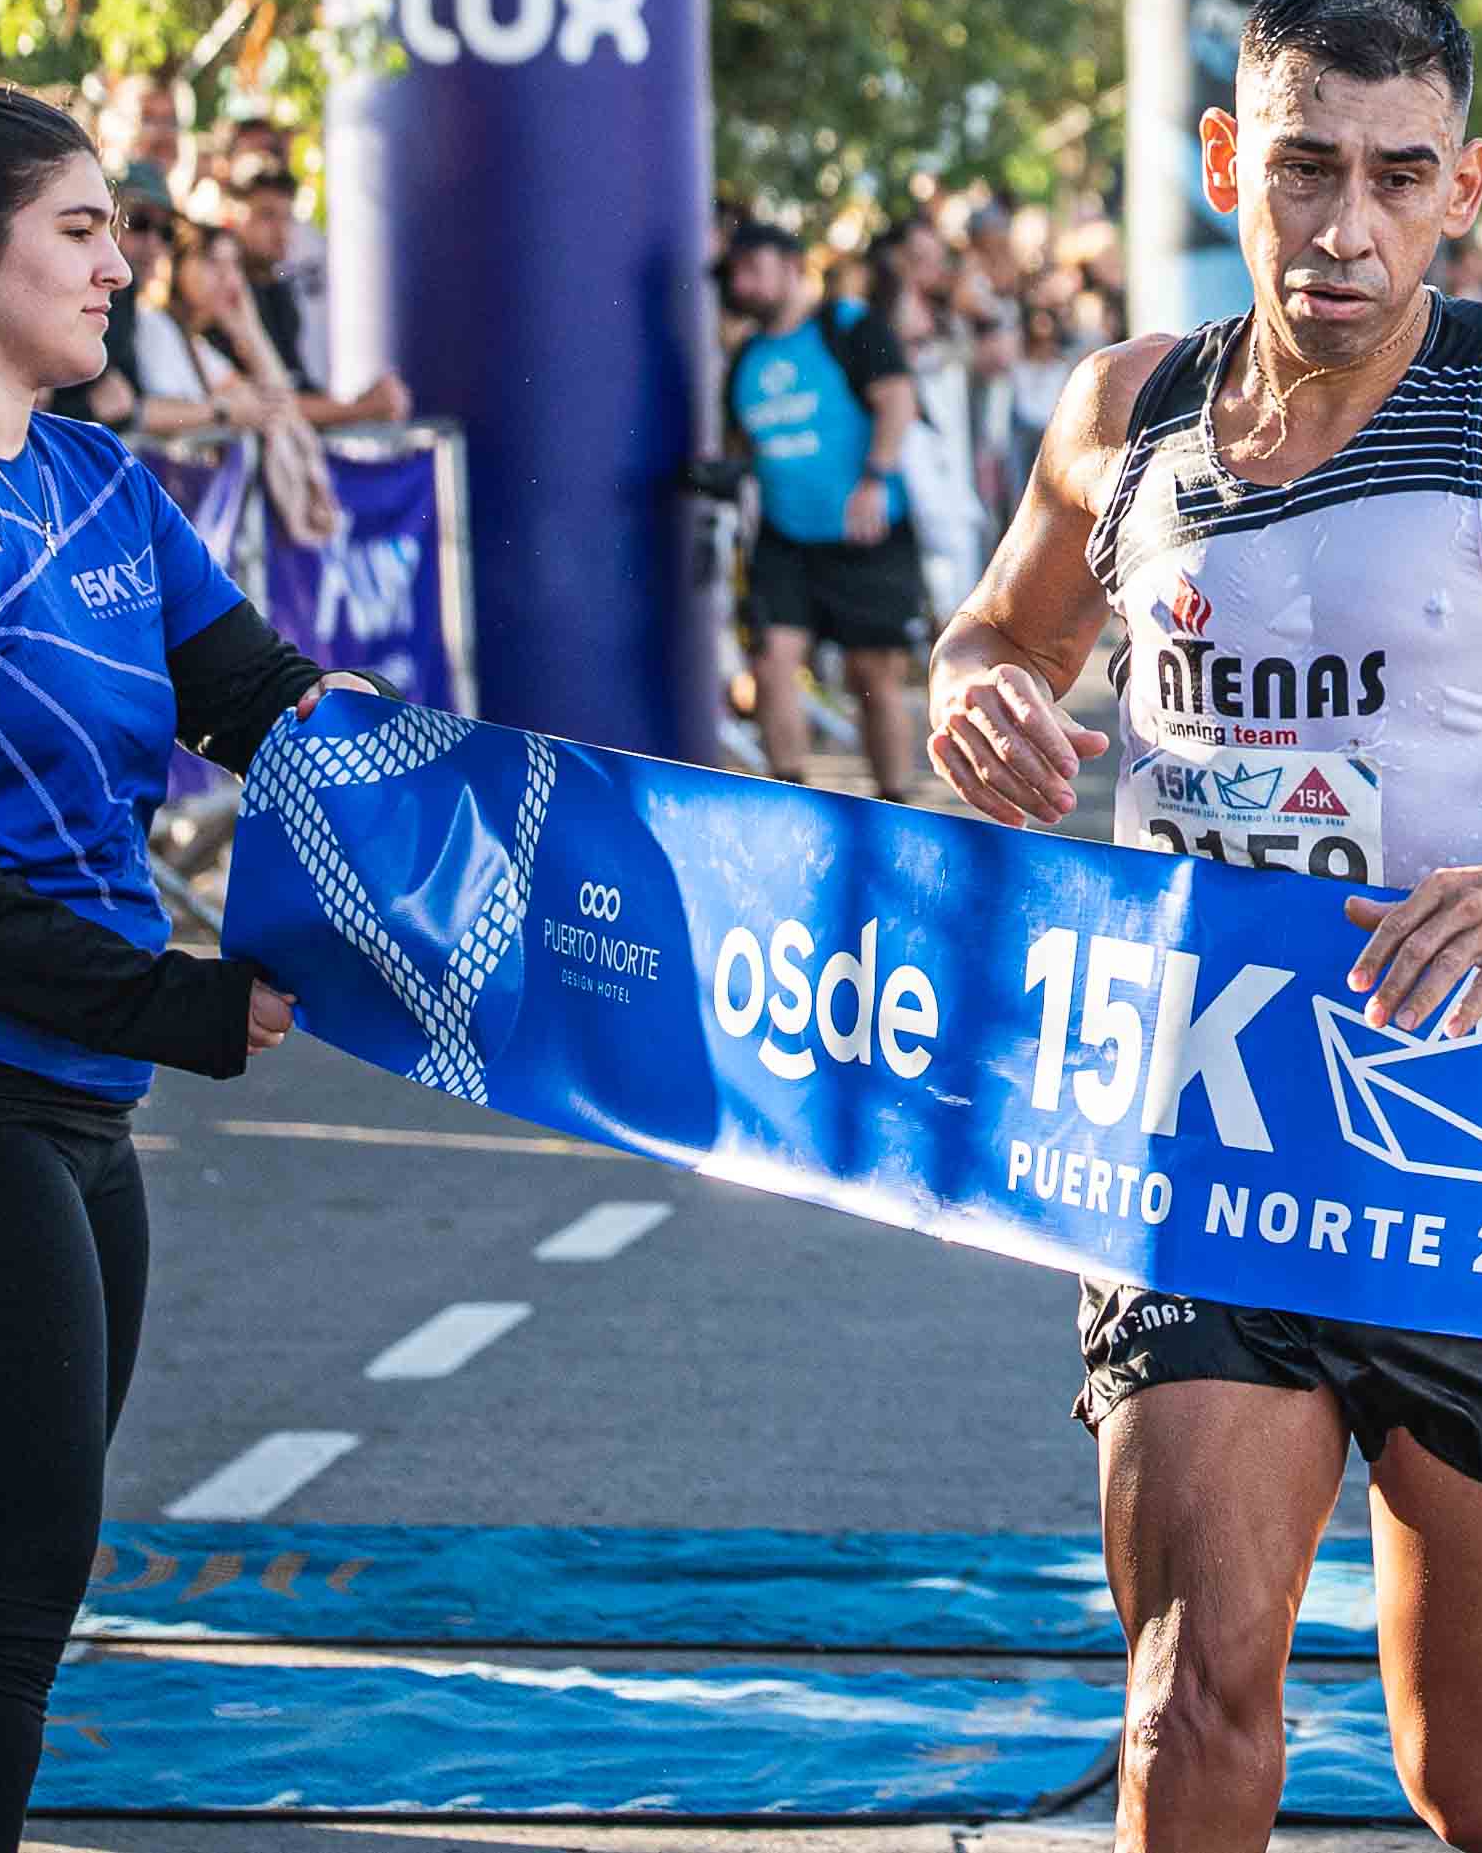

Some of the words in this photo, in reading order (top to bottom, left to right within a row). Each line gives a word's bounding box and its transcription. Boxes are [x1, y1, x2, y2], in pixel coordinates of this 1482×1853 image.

[71, 564, 131, 609] 15K
[1233, 724, 1298, 745] team
[1151, 763, 1210, 805] 15K
[1296, 788, 1334, 810] 15K
[544, 917, 597, 964] PUERTO
[600, 935, 661, 981] NORTE
[561, 968, 594, 993] DESIGN
[597, 982, 631, 1005] HOTEL
[713, 916, 940, 1081] osde
[1024, 927, 1297, 1153] 15K
[1007, 1140, 1174, 1226] PUERTO
[1204, 1182, 1447, 1268] NORTE
